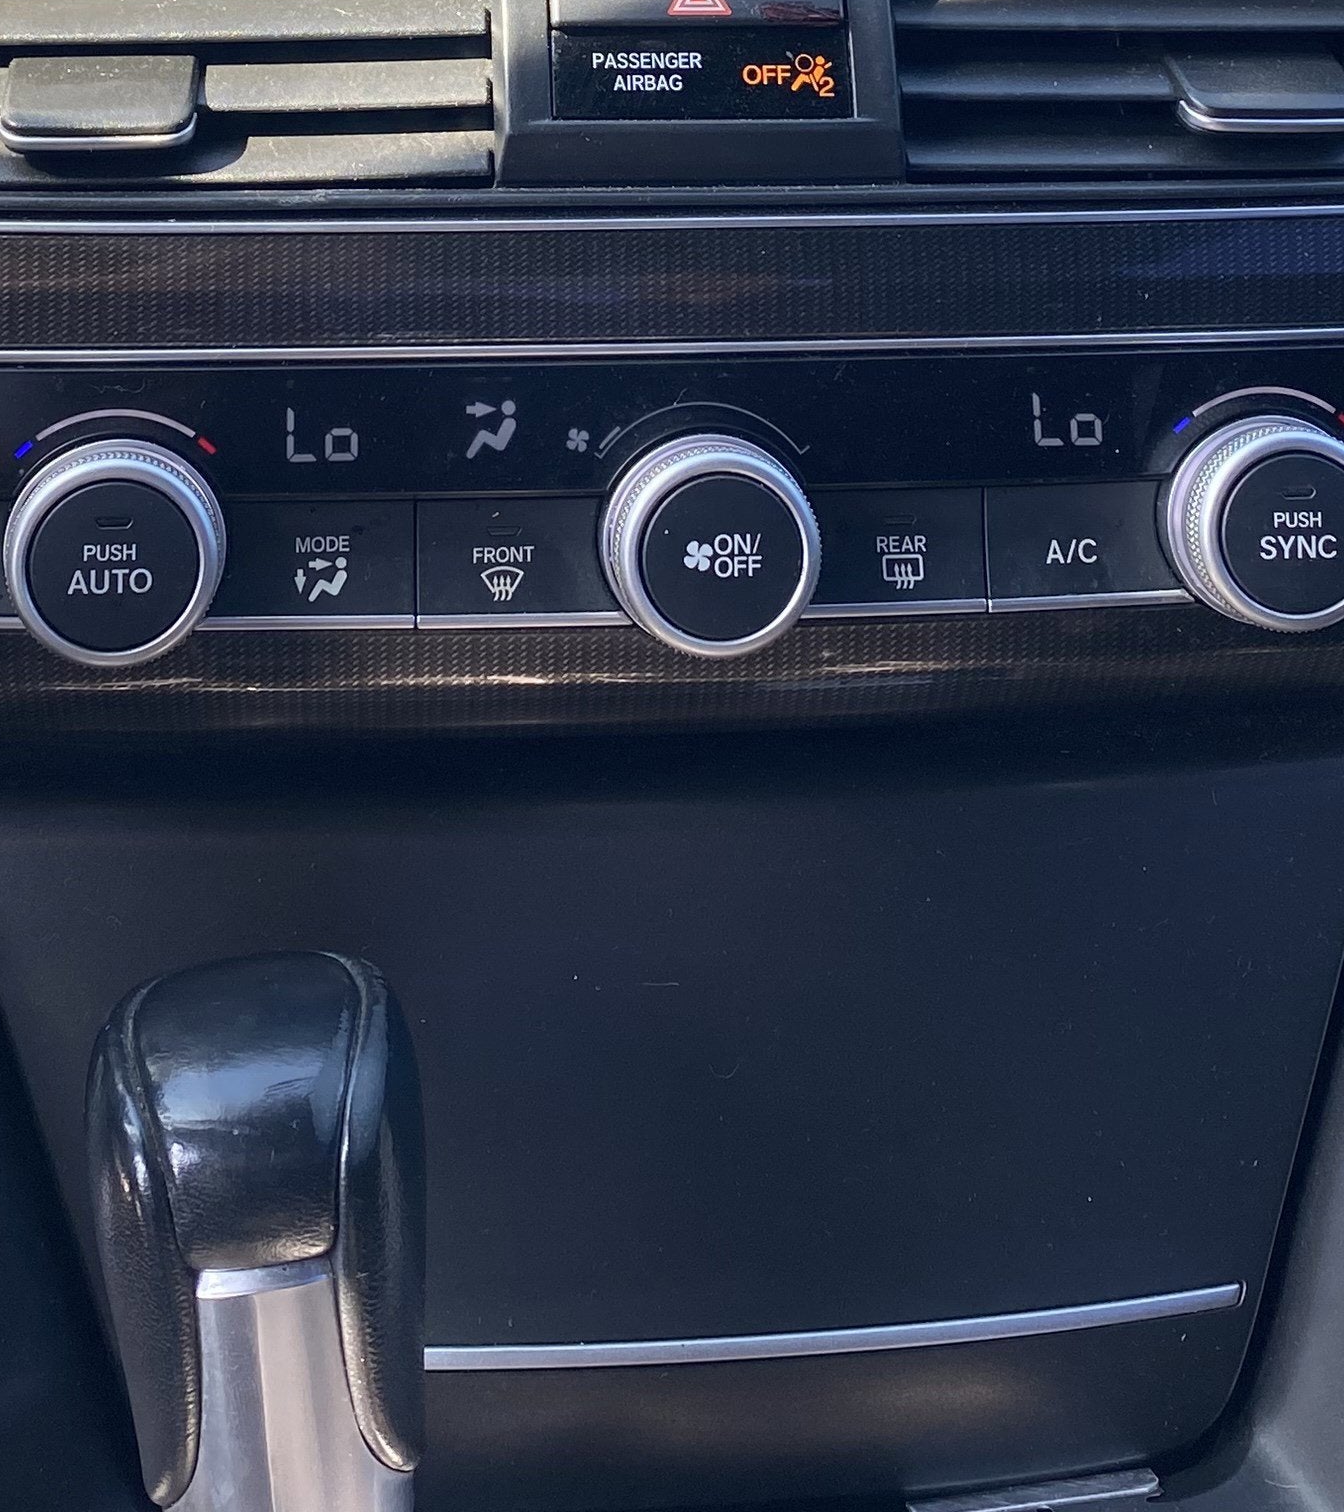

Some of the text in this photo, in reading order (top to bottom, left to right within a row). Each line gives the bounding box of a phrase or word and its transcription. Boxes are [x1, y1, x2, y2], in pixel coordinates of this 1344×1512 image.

[591, 52, 703, 70] PASSENGER
[613, 74, 683, 92] AIRBAG
[742, 64, 792, 86] OFF
[1272, 511, 1323, 530] PUSH
[82, 543, 137, 563] PUSH
[294, 535, 351, 554] MODE
[471, 544, 534, 564] FRONT
[712, 533, 762, 555] ON/
[875, 535, 927, 554] REAR
[1044, 538, 1099, 565] A/C
[1259, 532, 1338, 561] SYNC
[713, 554, 763, 578] OFF
[67, 568, 153, 595] AUTO
